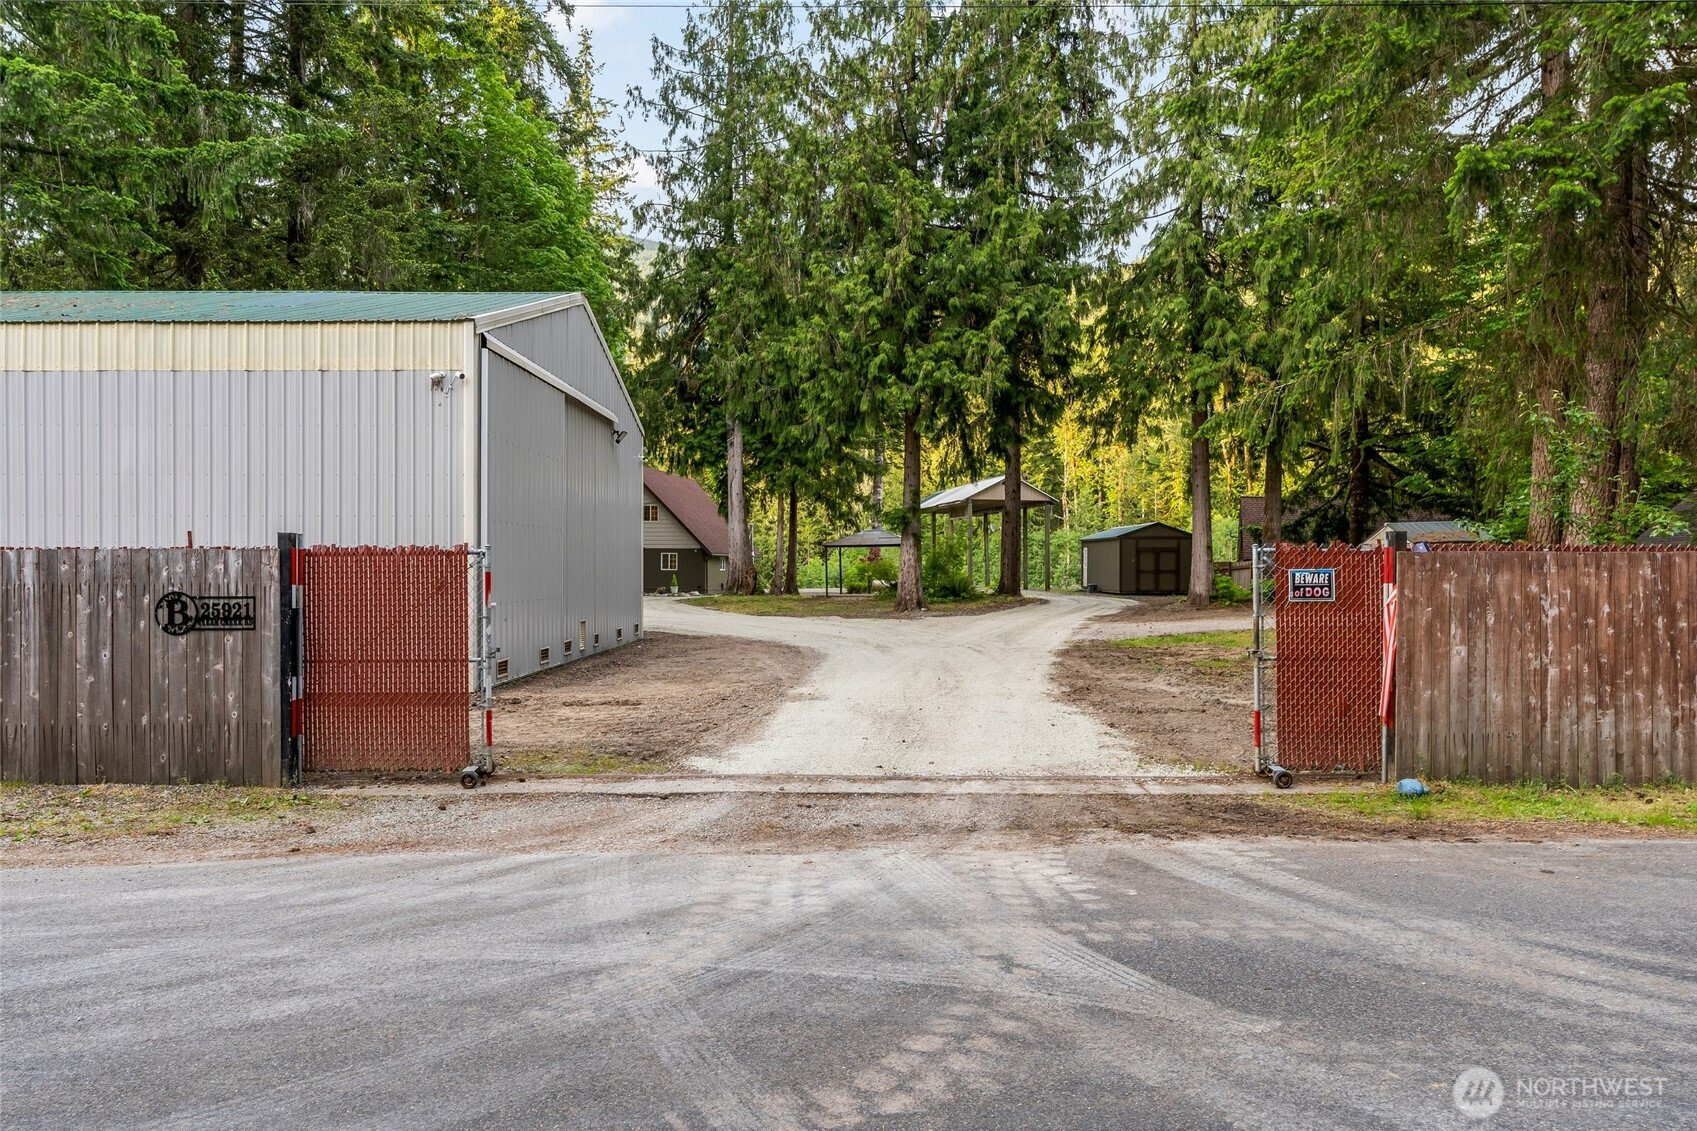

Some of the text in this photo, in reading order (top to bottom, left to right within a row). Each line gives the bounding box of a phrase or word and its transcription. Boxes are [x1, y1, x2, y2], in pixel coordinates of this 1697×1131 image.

[1295, 573, 1329, 584] BEWARE
[1294, 587, 1330, 597] of DOG
[200, 602, 252, 618] 25921
